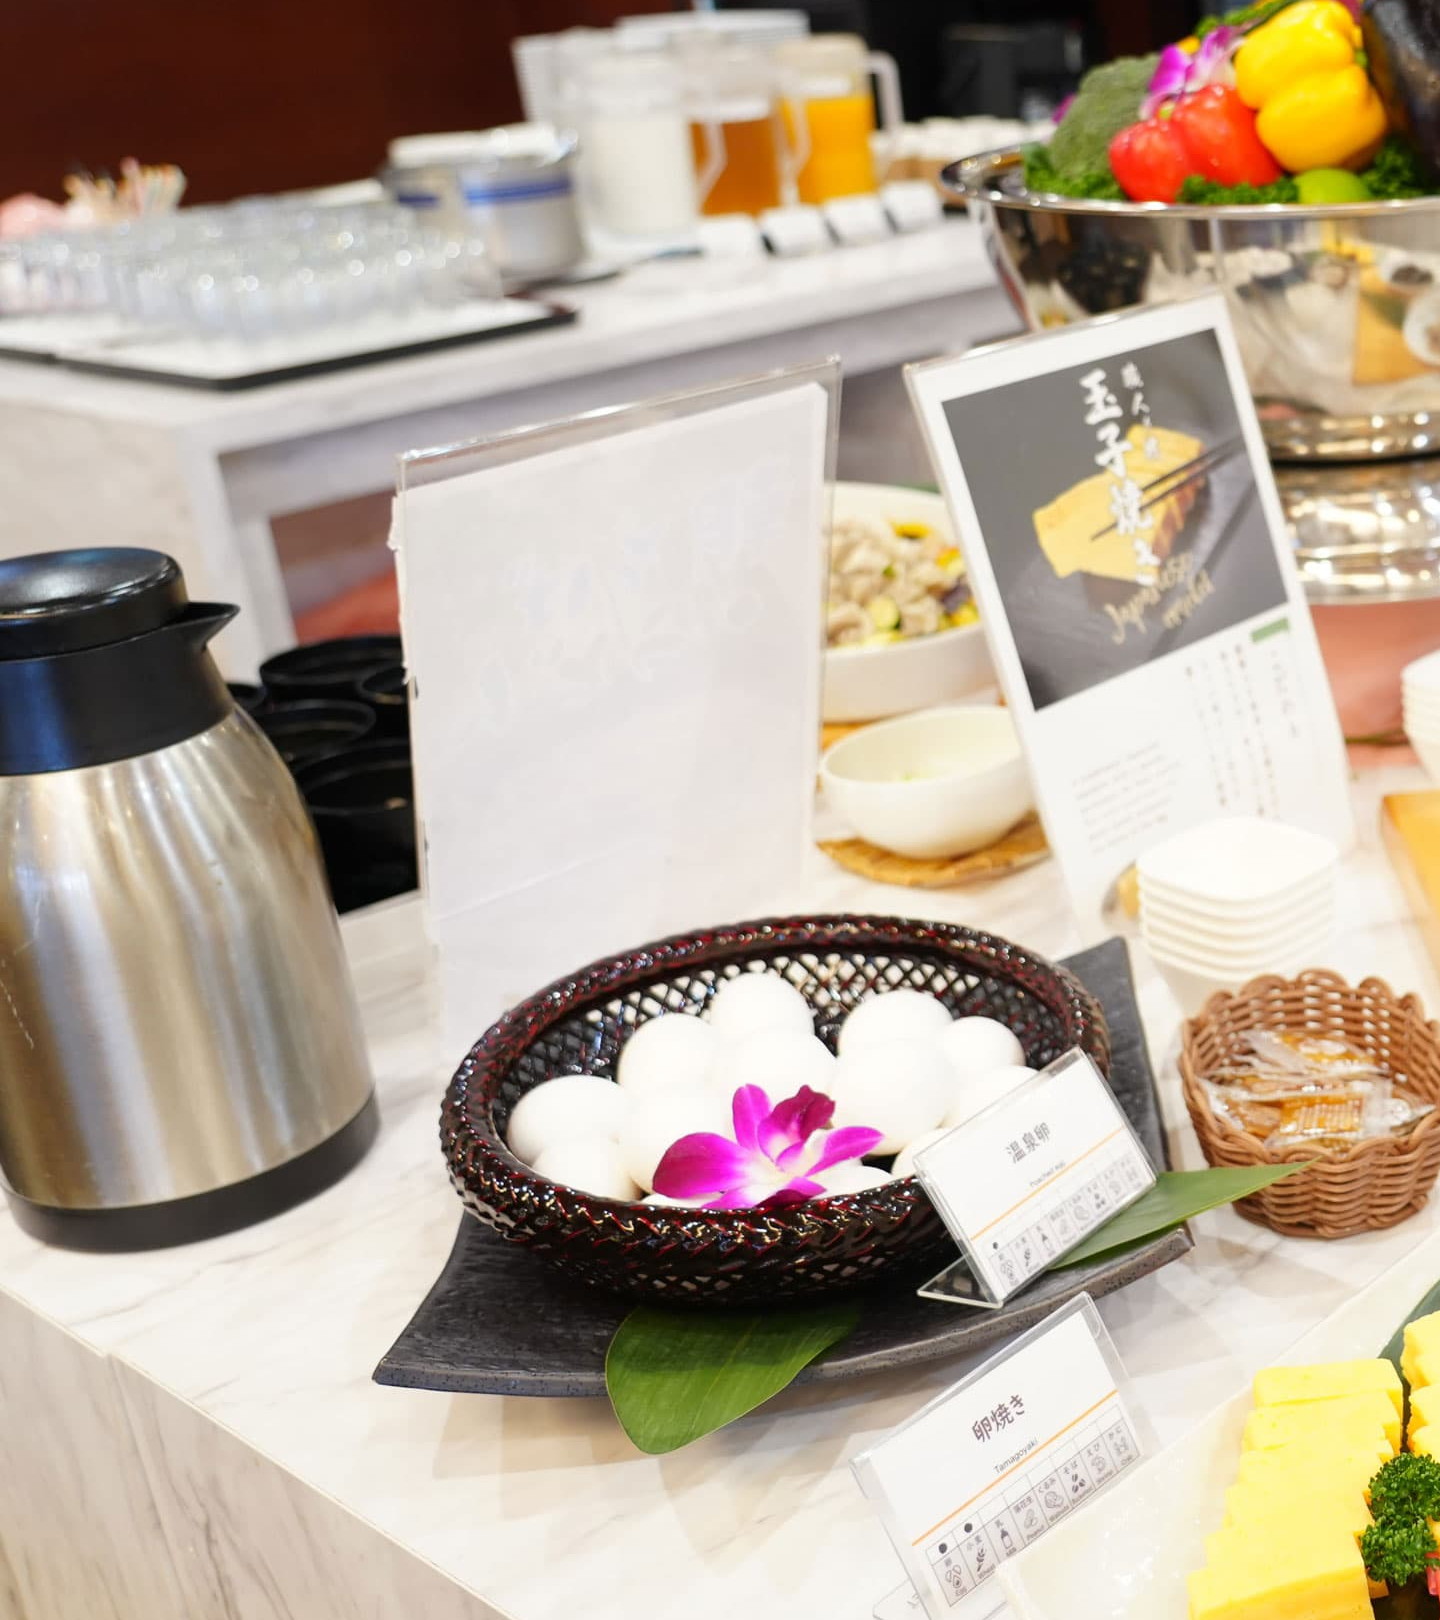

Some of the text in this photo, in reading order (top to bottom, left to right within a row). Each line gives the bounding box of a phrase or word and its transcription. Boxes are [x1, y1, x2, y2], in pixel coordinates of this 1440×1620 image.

[1079, 367, 1161, 586] 玉子焼き
[1005, 1121, 1051, 1165] 温泉卵
[972, 1394, 1025, 1443] 卵焼き
[993, 1436, 1039, 1474] Tamagoyaki
